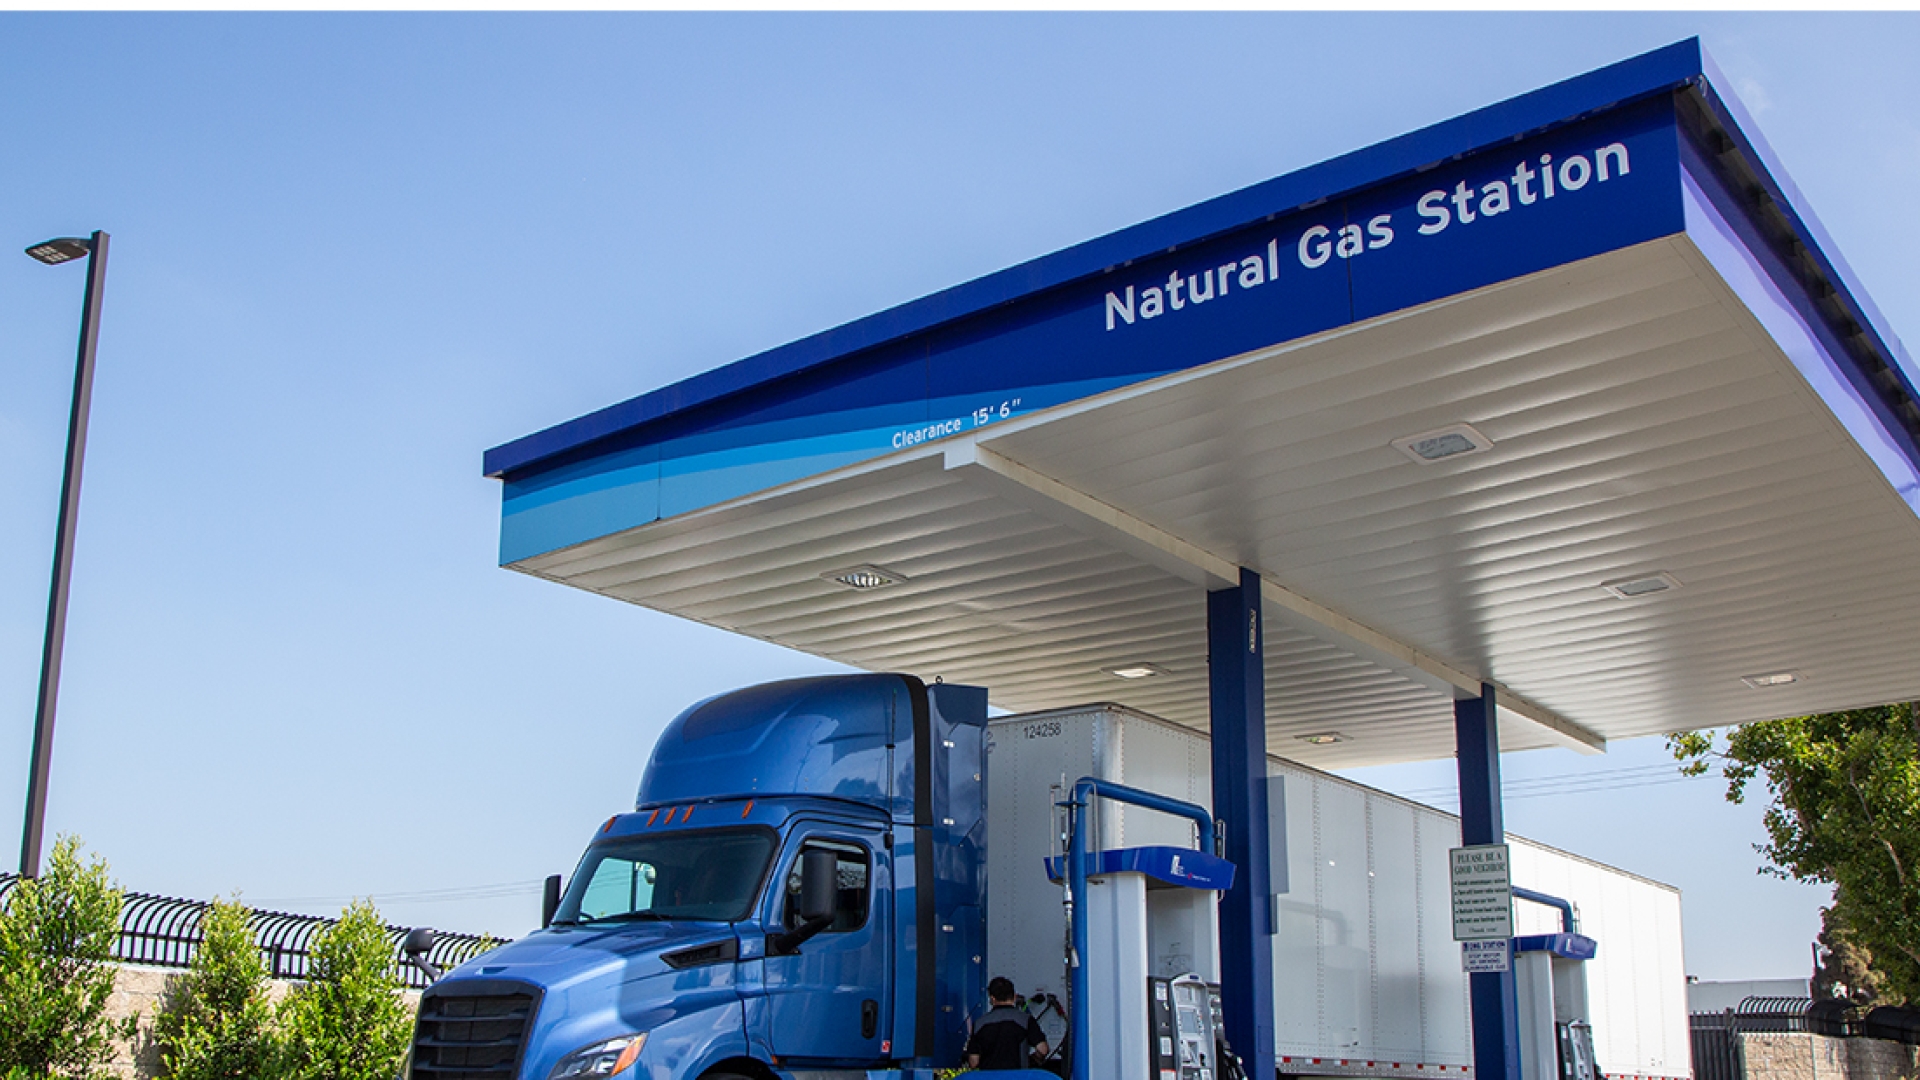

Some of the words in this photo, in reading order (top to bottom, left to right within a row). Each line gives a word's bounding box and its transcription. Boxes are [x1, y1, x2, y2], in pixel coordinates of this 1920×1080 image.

[1105, 239, 1280, 331] Natural
[1298, 212, 1394, 270] Gas
[1417, 142, 1631, 235] Station
[892, 417, 961, 449] Clearance
[972, 405, 994, 426] 15'
[1023, 721, 1062, 739] 124258
